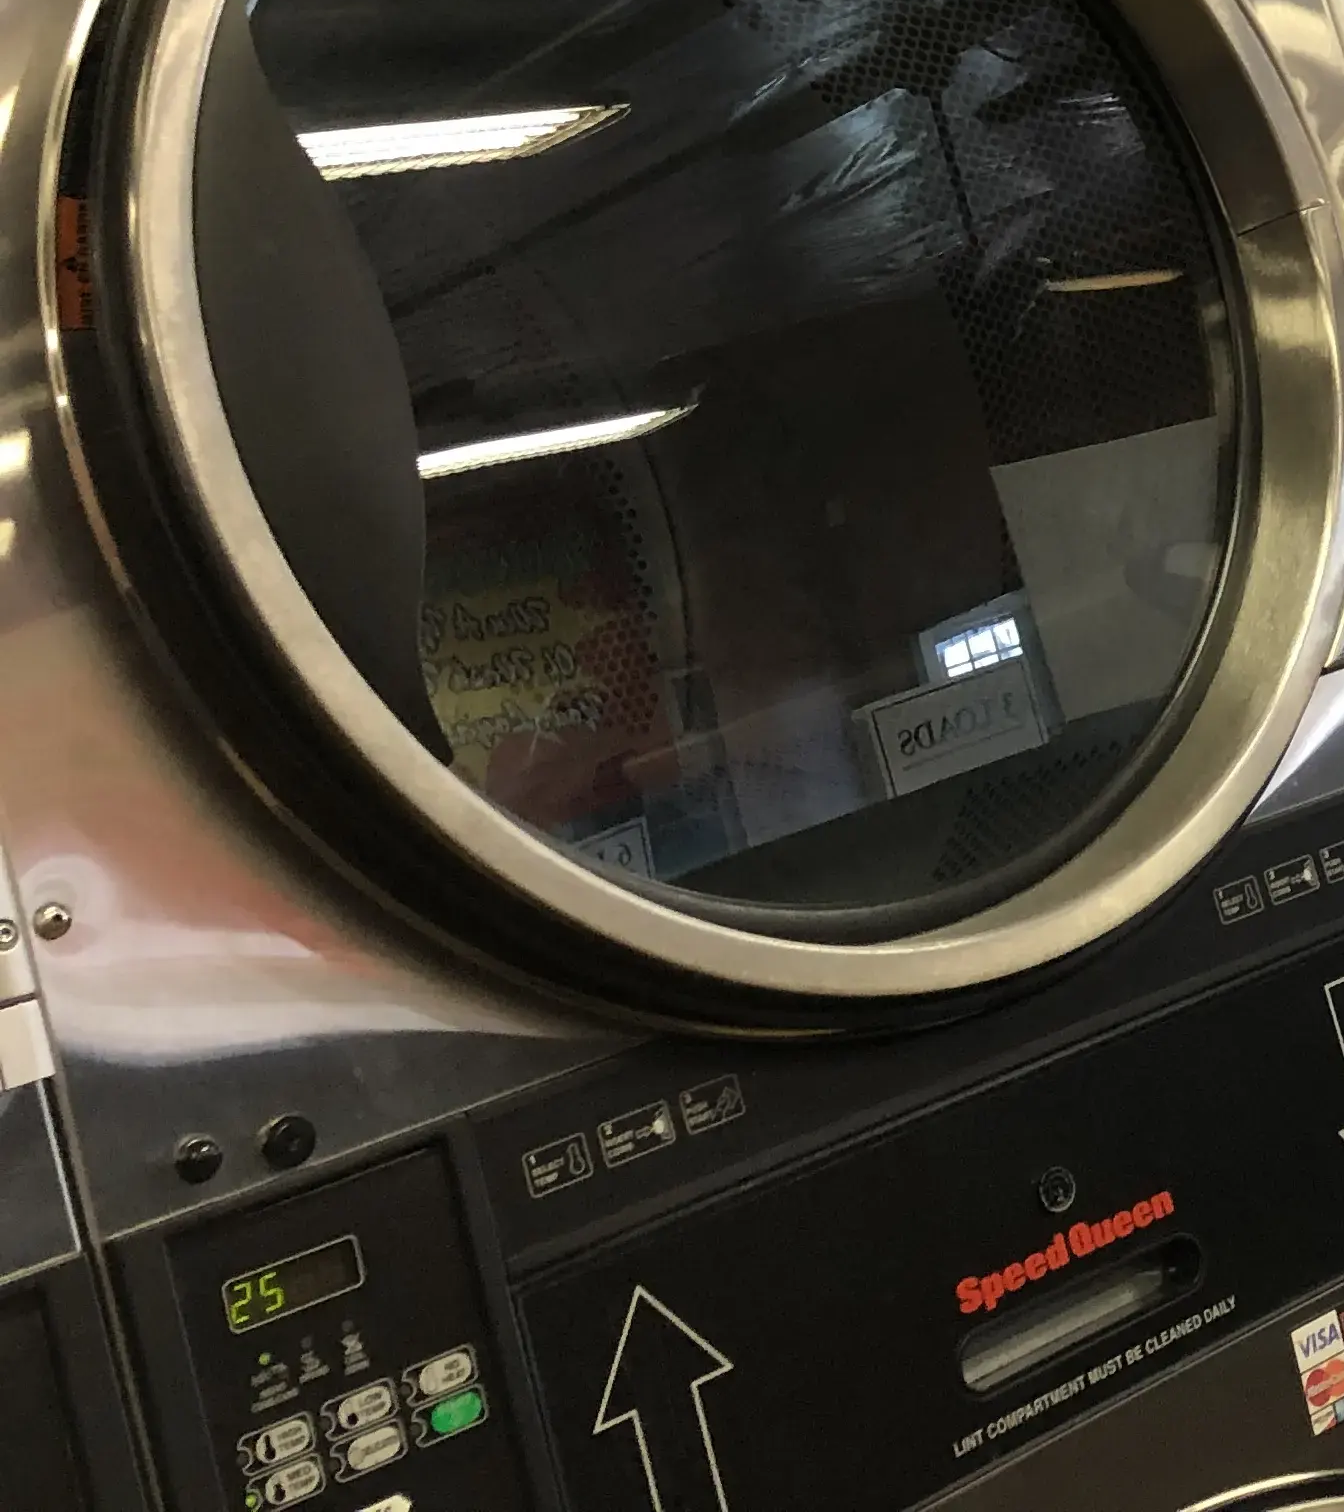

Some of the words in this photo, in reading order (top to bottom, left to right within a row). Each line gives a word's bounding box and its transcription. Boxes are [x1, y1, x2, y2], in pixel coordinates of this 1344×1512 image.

[955, 1233, 1071, 1315] Speed
[1067, 1190, 1175, 1259] Queen
[231, 1271, 284, 1324] 25
[1300, 1323, 1339, 1358] VISA
[952, 1428, 984, 1459] LINT
[987, 1375, 1086, 1440] COMPARTMENT
[1088, 1355, 1123, 1387] MUST
[1125, 1345, 1144, 1365] BE
[1145, 1314, 1202, 1357] CLEANED
[1203, 1294, 1236, 1326] DAILY
